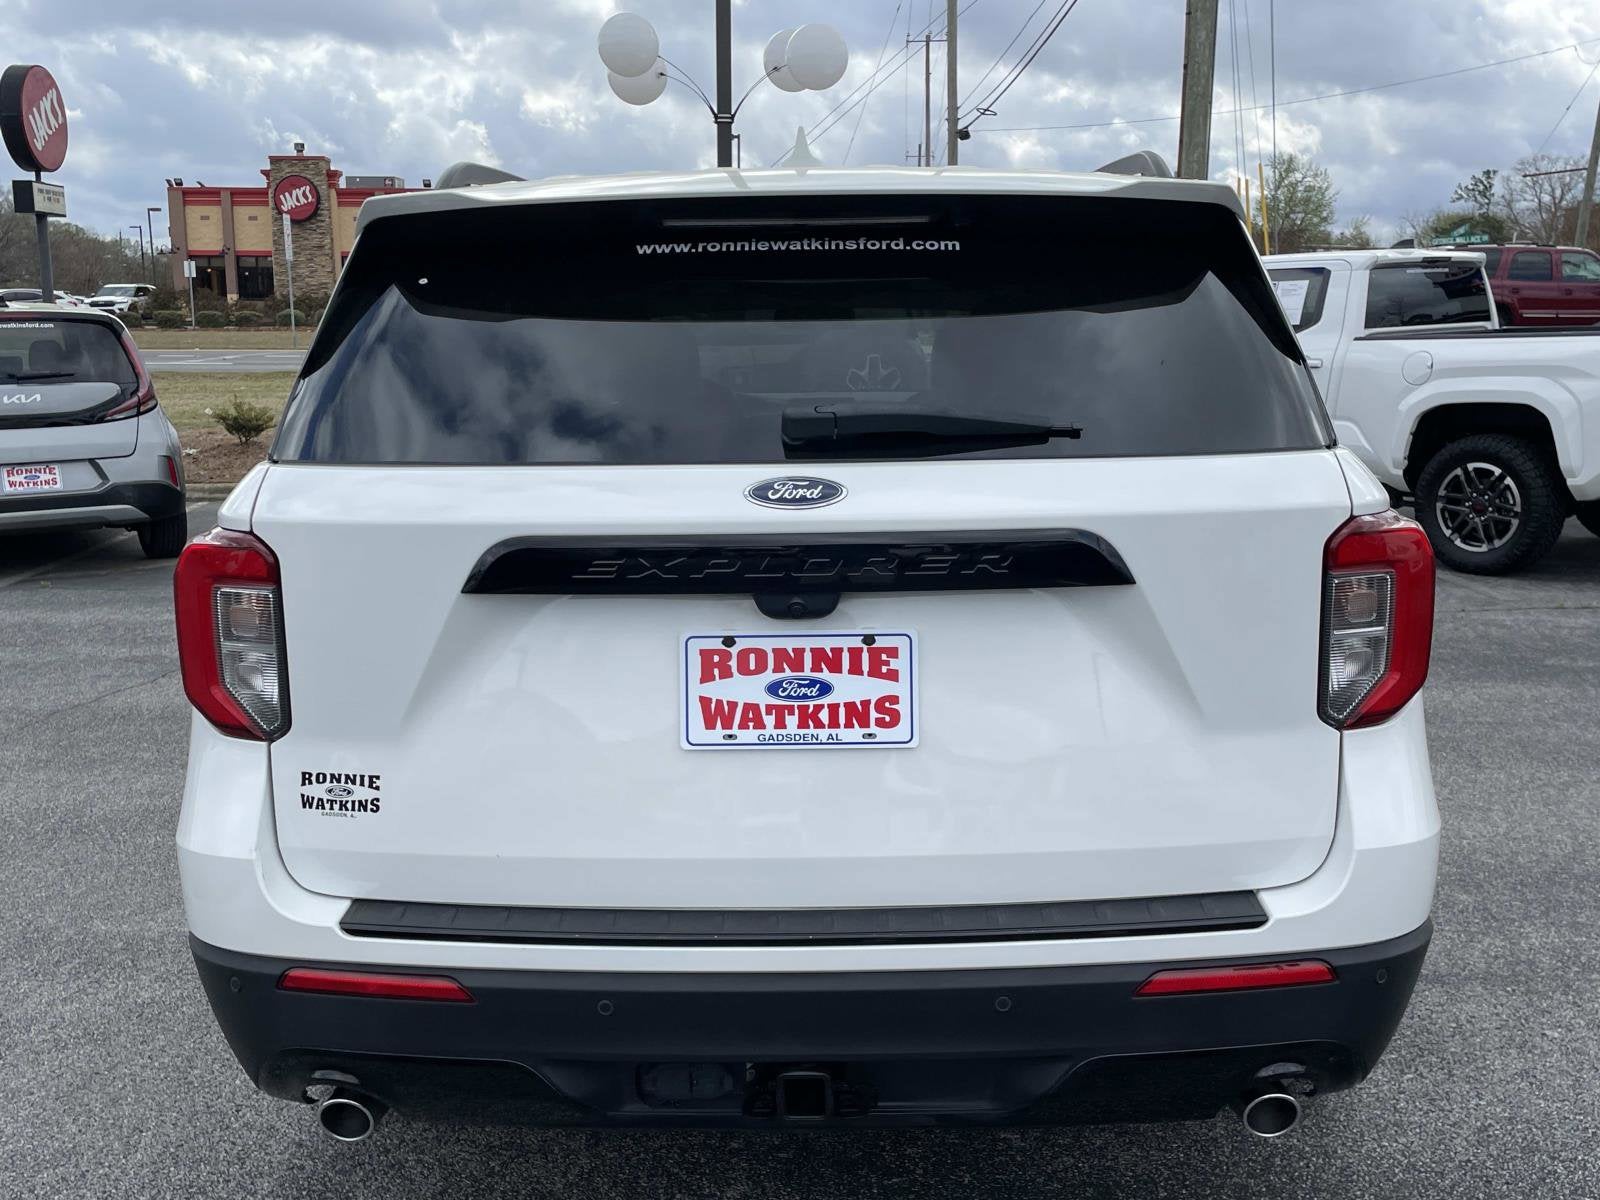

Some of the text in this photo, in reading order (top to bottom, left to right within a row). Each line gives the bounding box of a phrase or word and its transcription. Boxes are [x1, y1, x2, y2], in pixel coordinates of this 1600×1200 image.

[636, 237, 961, 254] www.ronniewatkinsford.com
[6, 467, 56, 477] RONNIE
[8, 478, 58, 488] WATKINS
[768, 480, 823, 500] Ford
[571, 554, 1015, 579] EXPLORER
[698, 646, 900, 684] RONNIE
[778, 680, 820, 698] Ford
[698, 694, 902, 731] WATKINS
[757, 733, 843, 743] GADSDEN, AL
[300, 771, 381, 791] RONNIE
[300, 793, 381, 813] WATKINS
